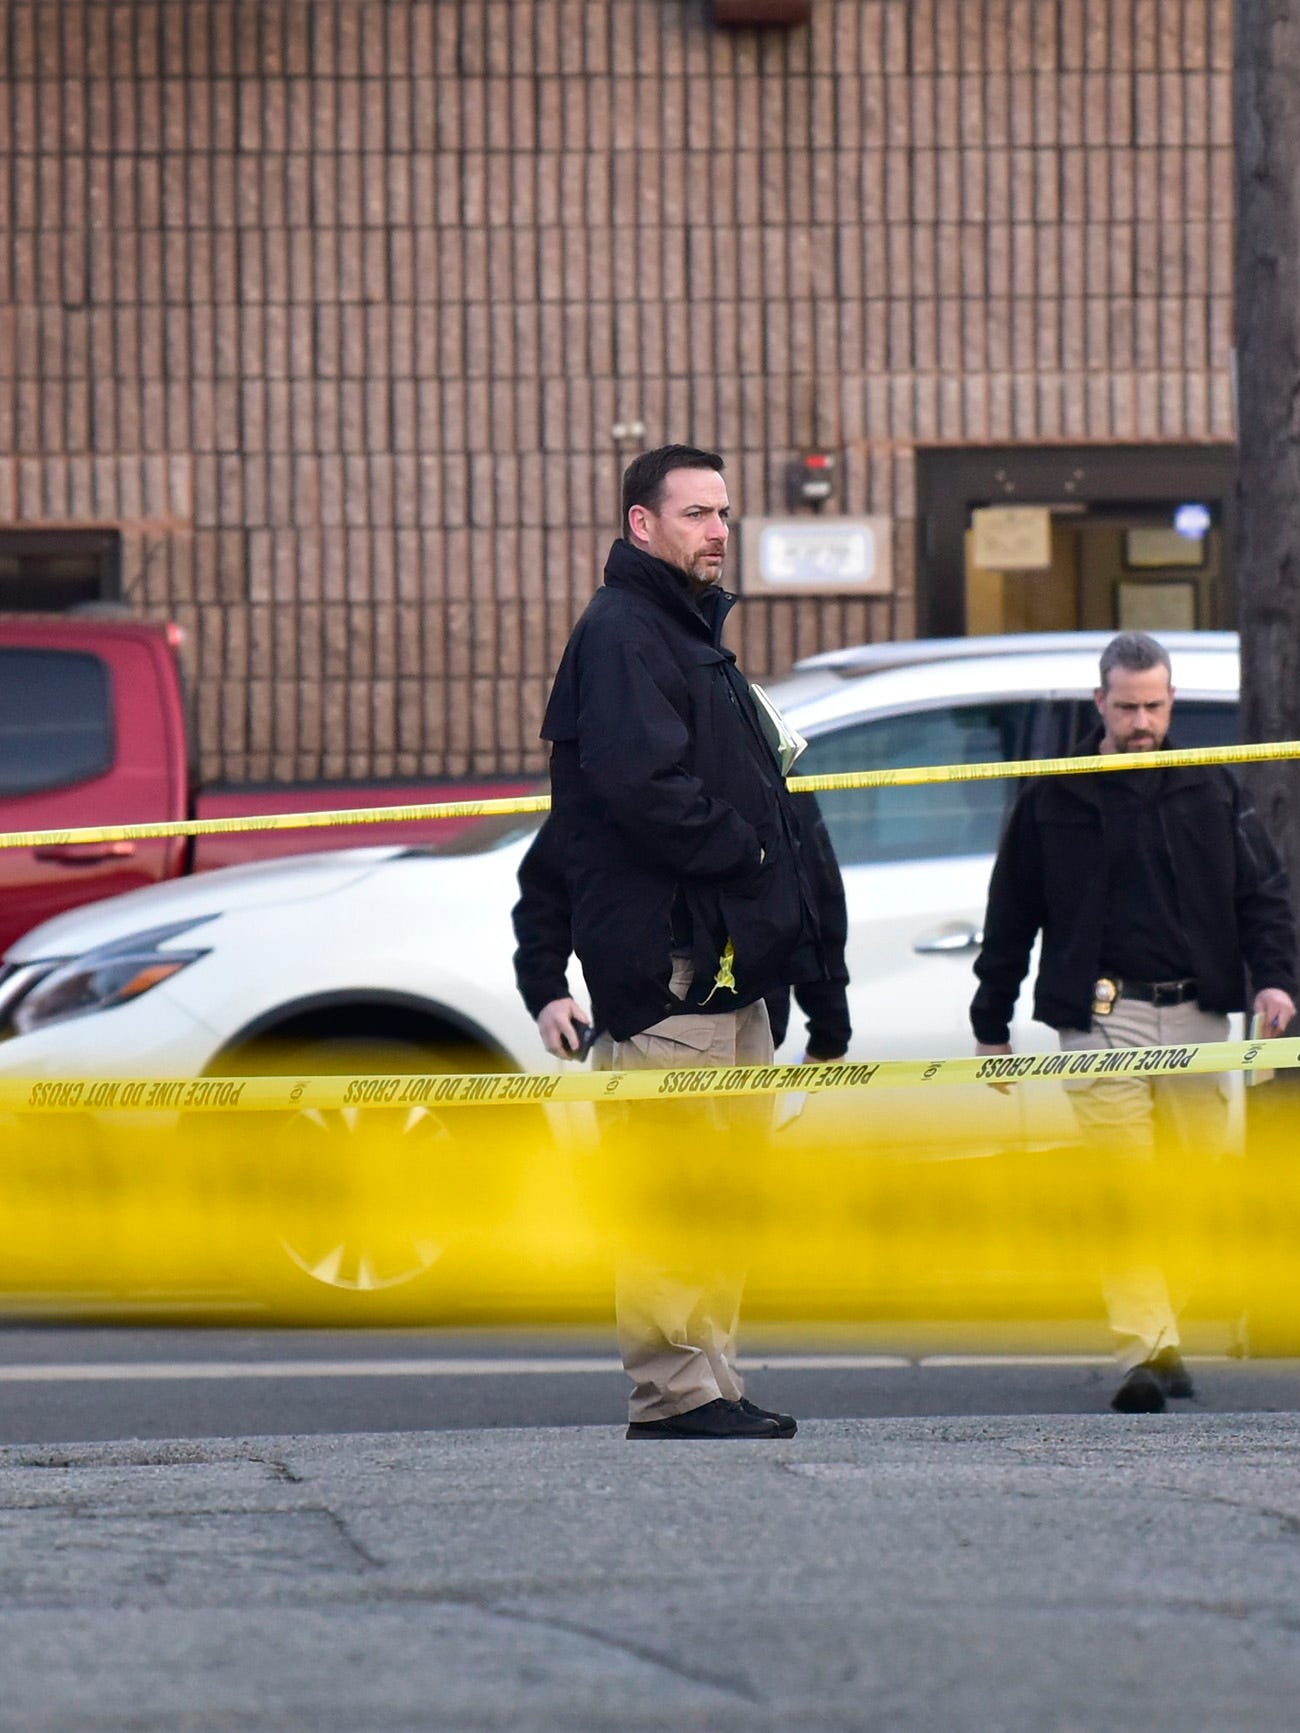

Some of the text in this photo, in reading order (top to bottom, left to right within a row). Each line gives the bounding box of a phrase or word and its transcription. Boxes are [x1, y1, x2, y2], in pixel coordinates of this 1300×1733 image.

[975, 1048, 1198, 1078] POLICE LINE DO NOT CROSS
[344, 1077, 562, 1101] POLICE LINE DO NOT CROSS
[658, 1065, 878, 1092] POLICE LINE DO NOT CROSS
